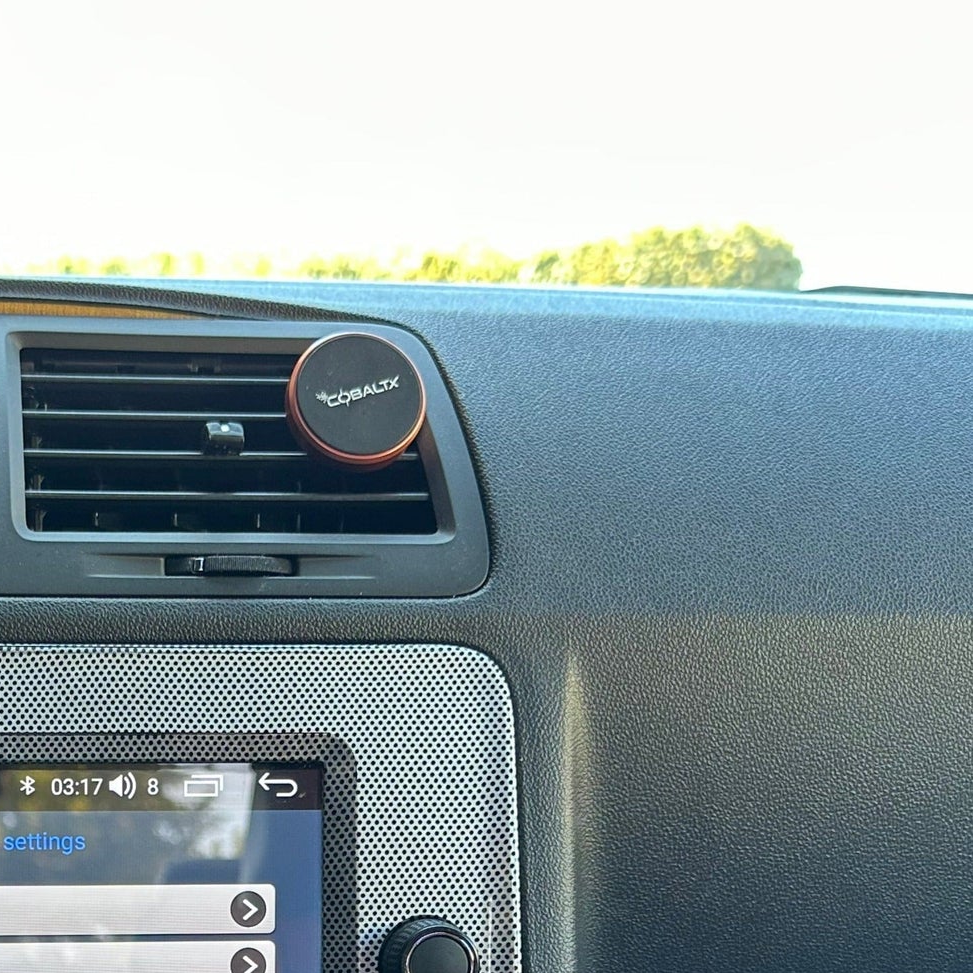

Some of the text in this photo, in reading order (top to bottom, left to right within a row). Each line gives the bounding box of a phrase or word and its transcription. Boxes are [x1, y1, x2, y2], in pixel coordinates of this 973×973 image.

[327, 374, 400, 407] COBALTX
[50, 776, 105, 797] 03:17
[146, 777, 160, 797] 8
[2, 831, 87, 856] settings
